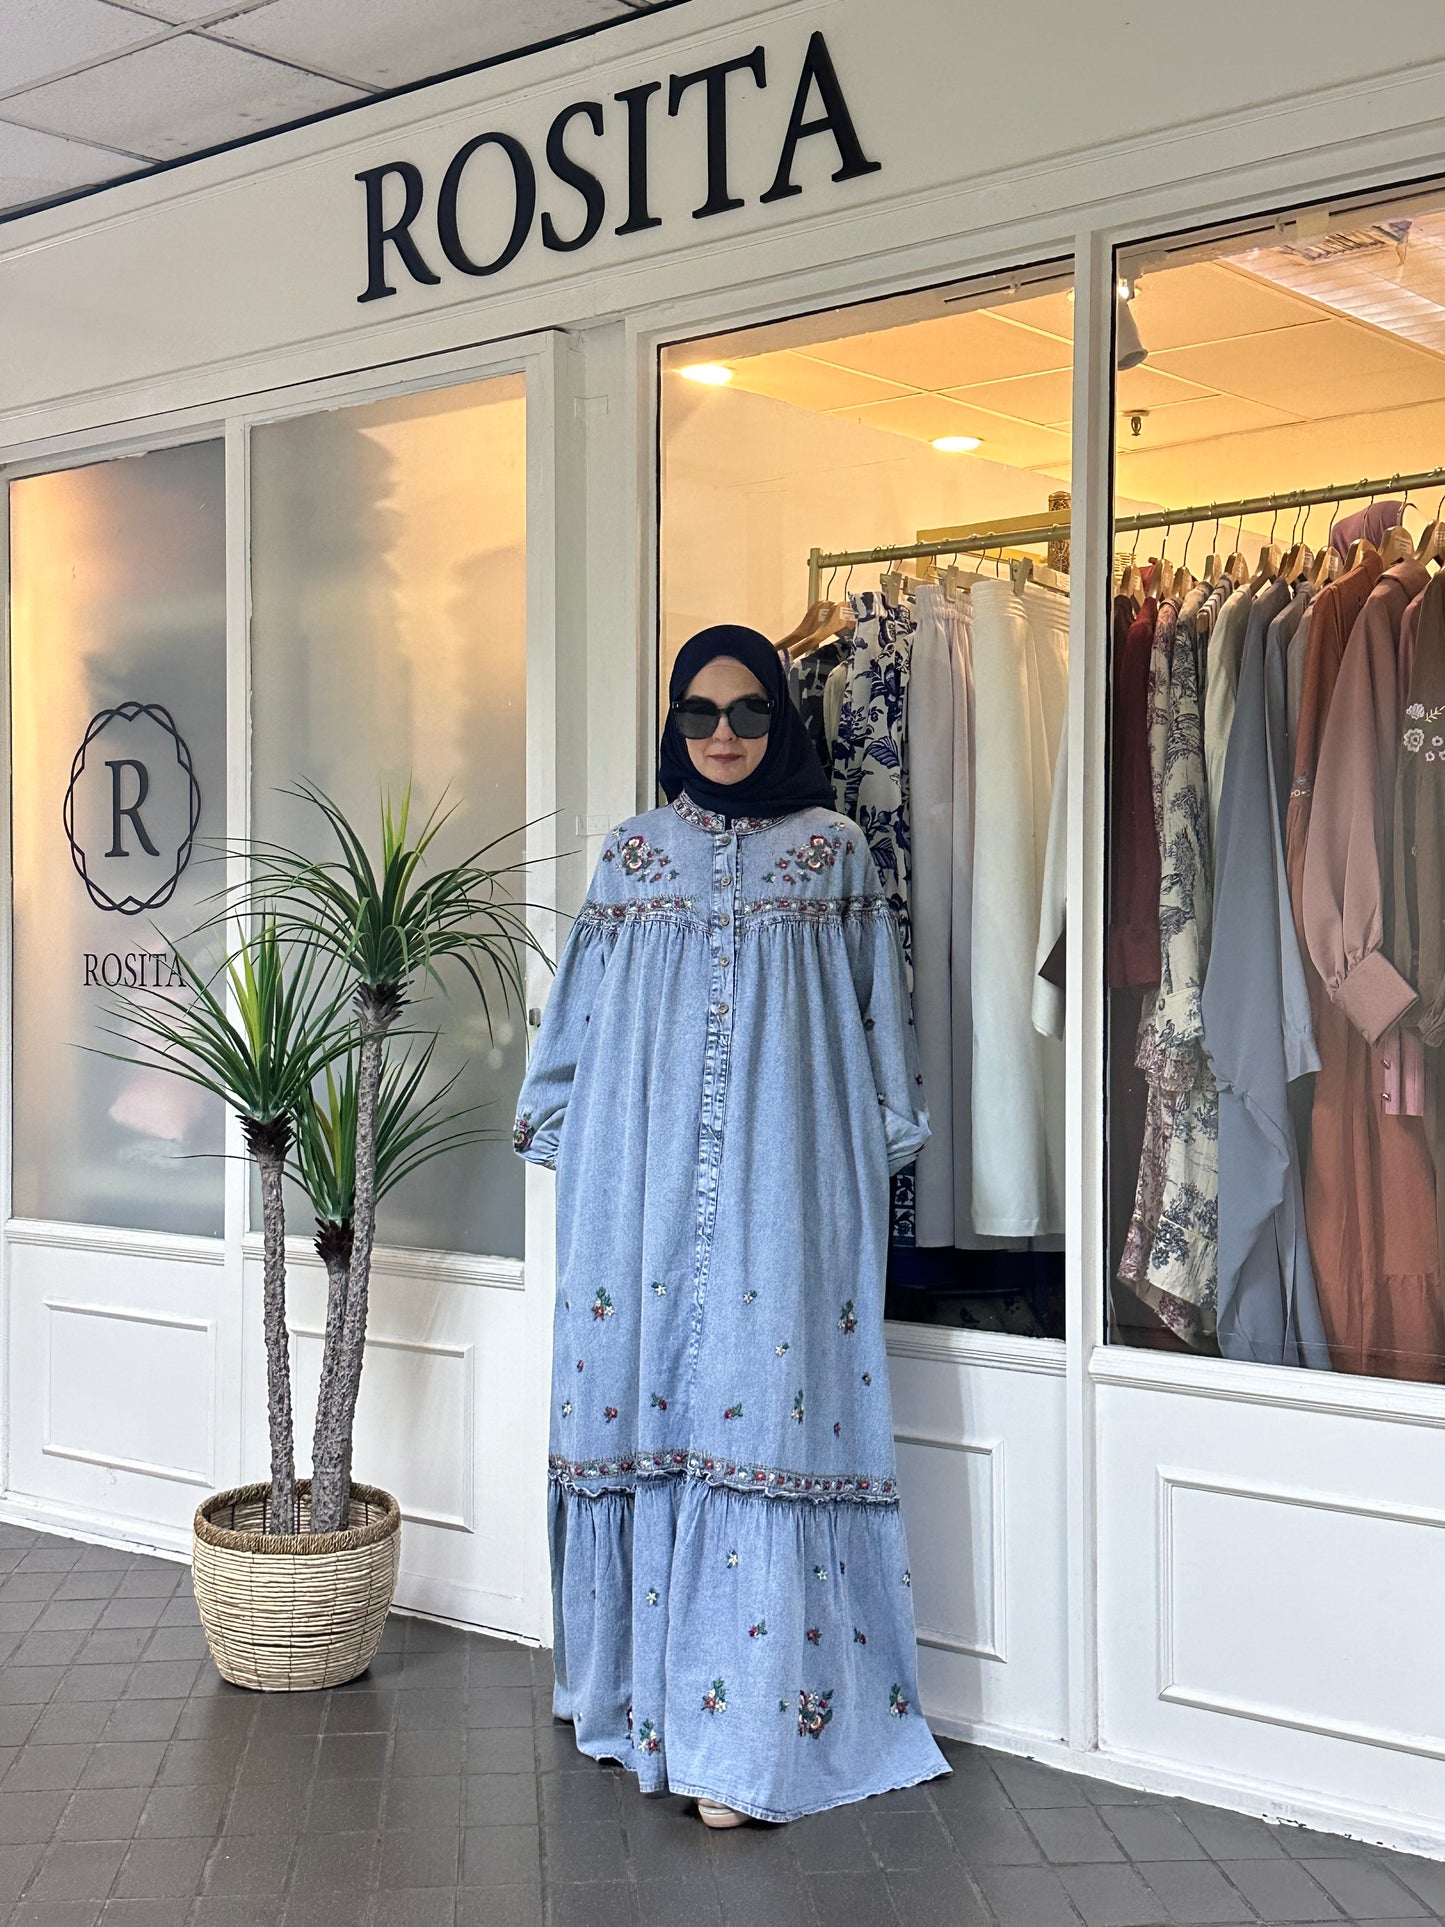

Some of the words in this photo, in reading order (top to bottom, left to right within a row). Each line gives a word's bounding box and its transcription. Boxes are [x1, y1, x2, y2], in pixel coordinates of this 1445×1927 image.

[354, 30, 882, 304] ROSITA
[104, 759, 161, 858] R
[83, 952, 187, 988] ROSITA
